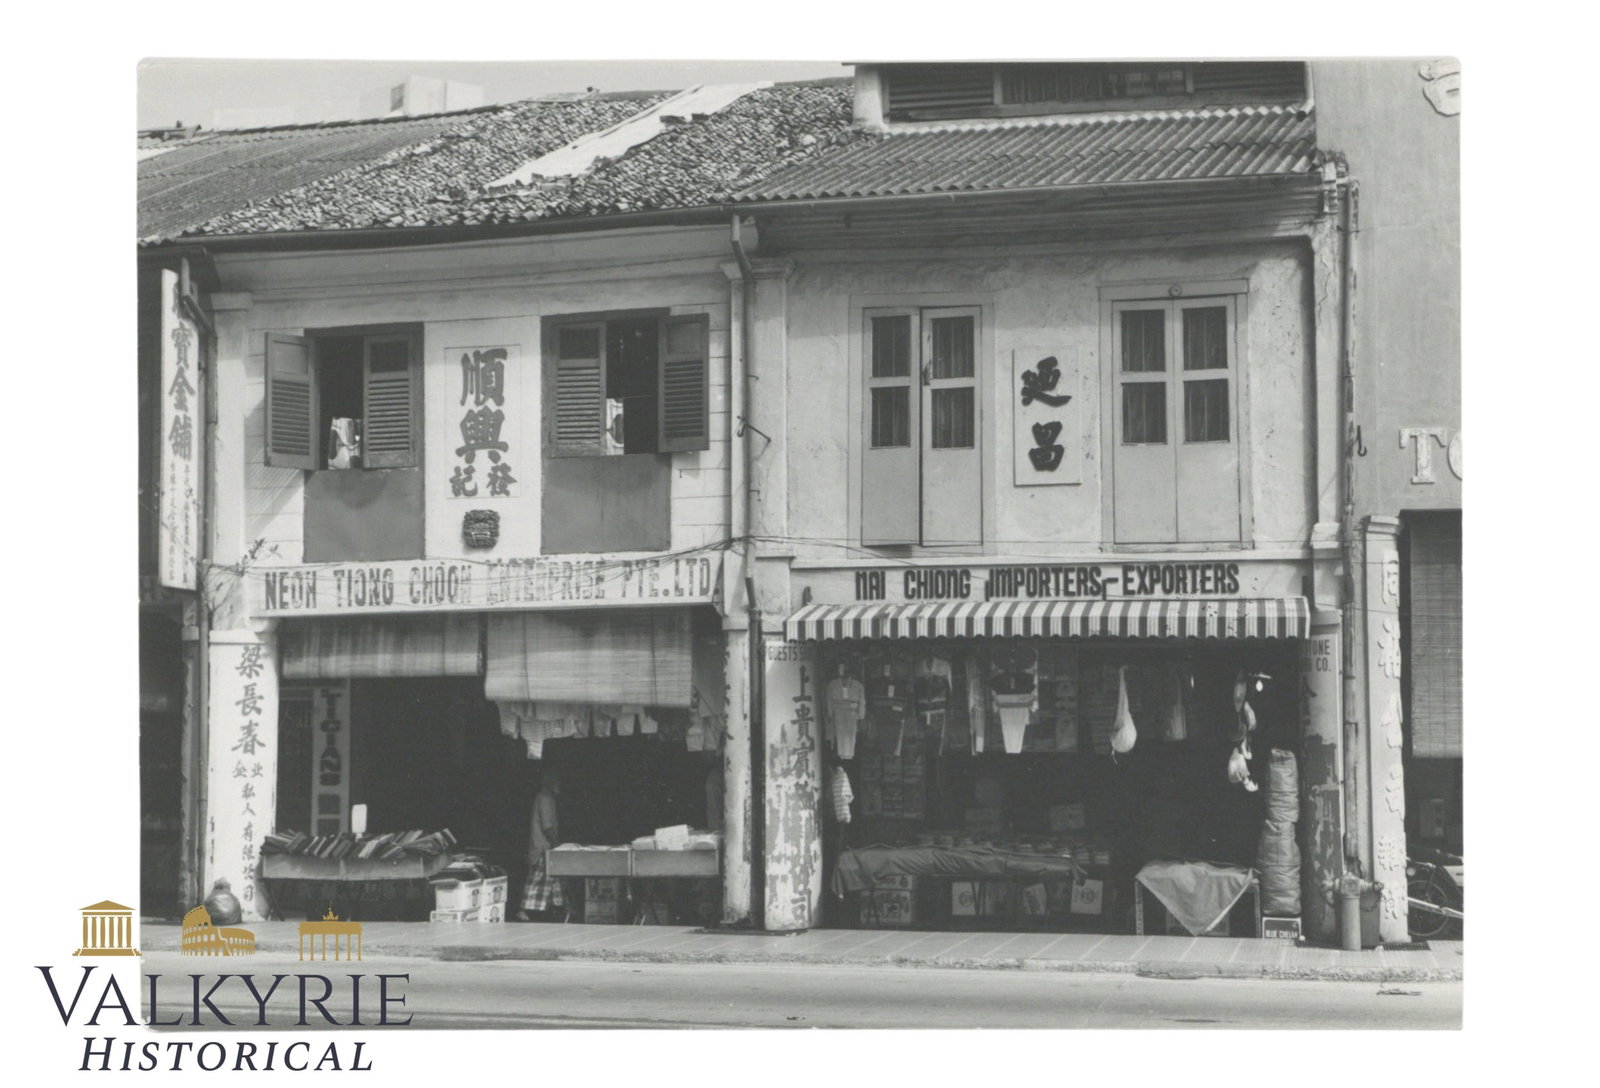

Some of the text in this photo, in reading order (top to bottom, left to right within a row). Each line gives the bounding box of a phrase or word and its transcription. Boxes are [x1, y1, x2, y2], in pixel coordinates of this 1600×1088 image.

[265, 570, 317, 610] NEOH
[333, 567, 394, 607] TIONG
[409, 564, 473, 604] CHOON
[904, 568, 971, 599] CHIONG
